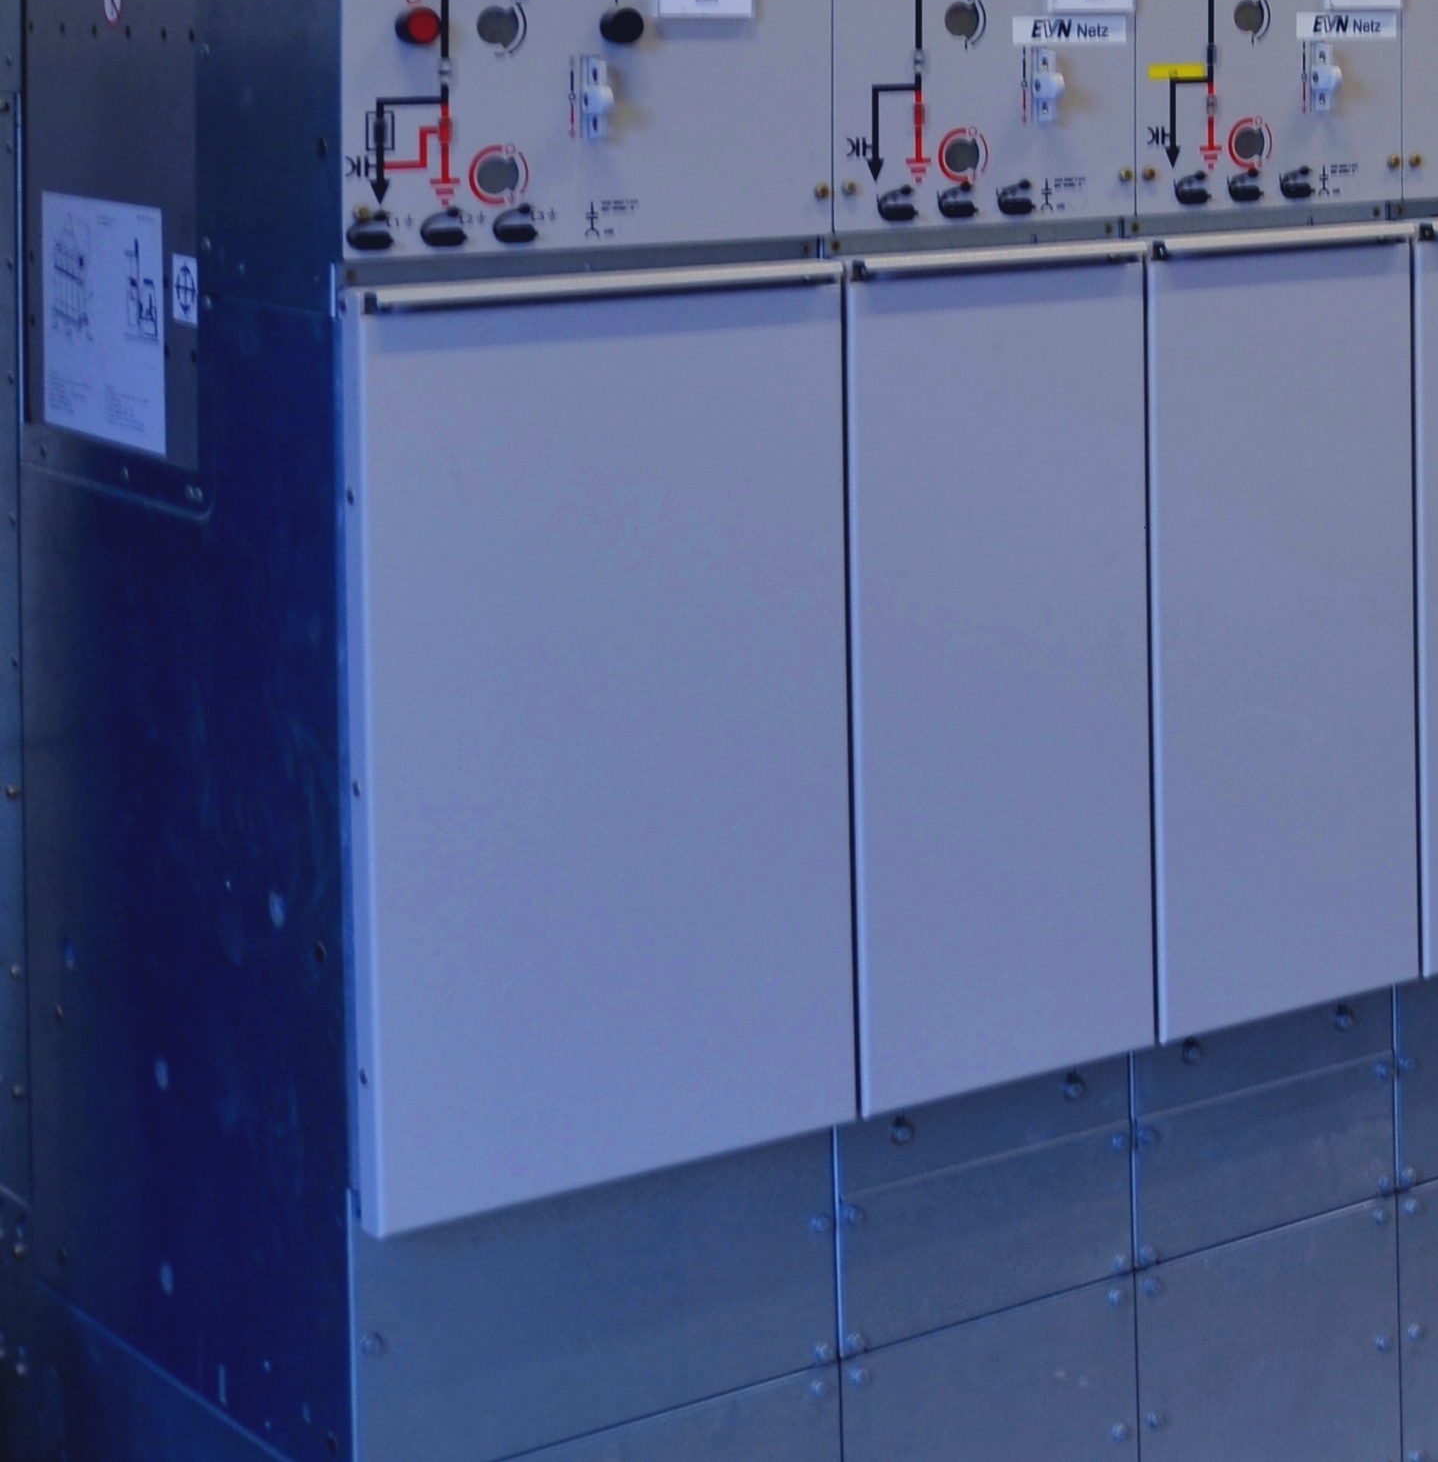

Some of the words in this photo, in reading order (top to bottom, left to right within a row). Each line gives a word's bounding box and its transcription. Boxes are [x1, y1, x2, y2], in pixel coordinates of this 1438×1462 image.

[1031, 19, 1072, 38] EVN
[1077, 23, 1109, 38] Netz
[1313, 14, 1349, 33] EVN
[1353, 18, 1381, 33] Netz
